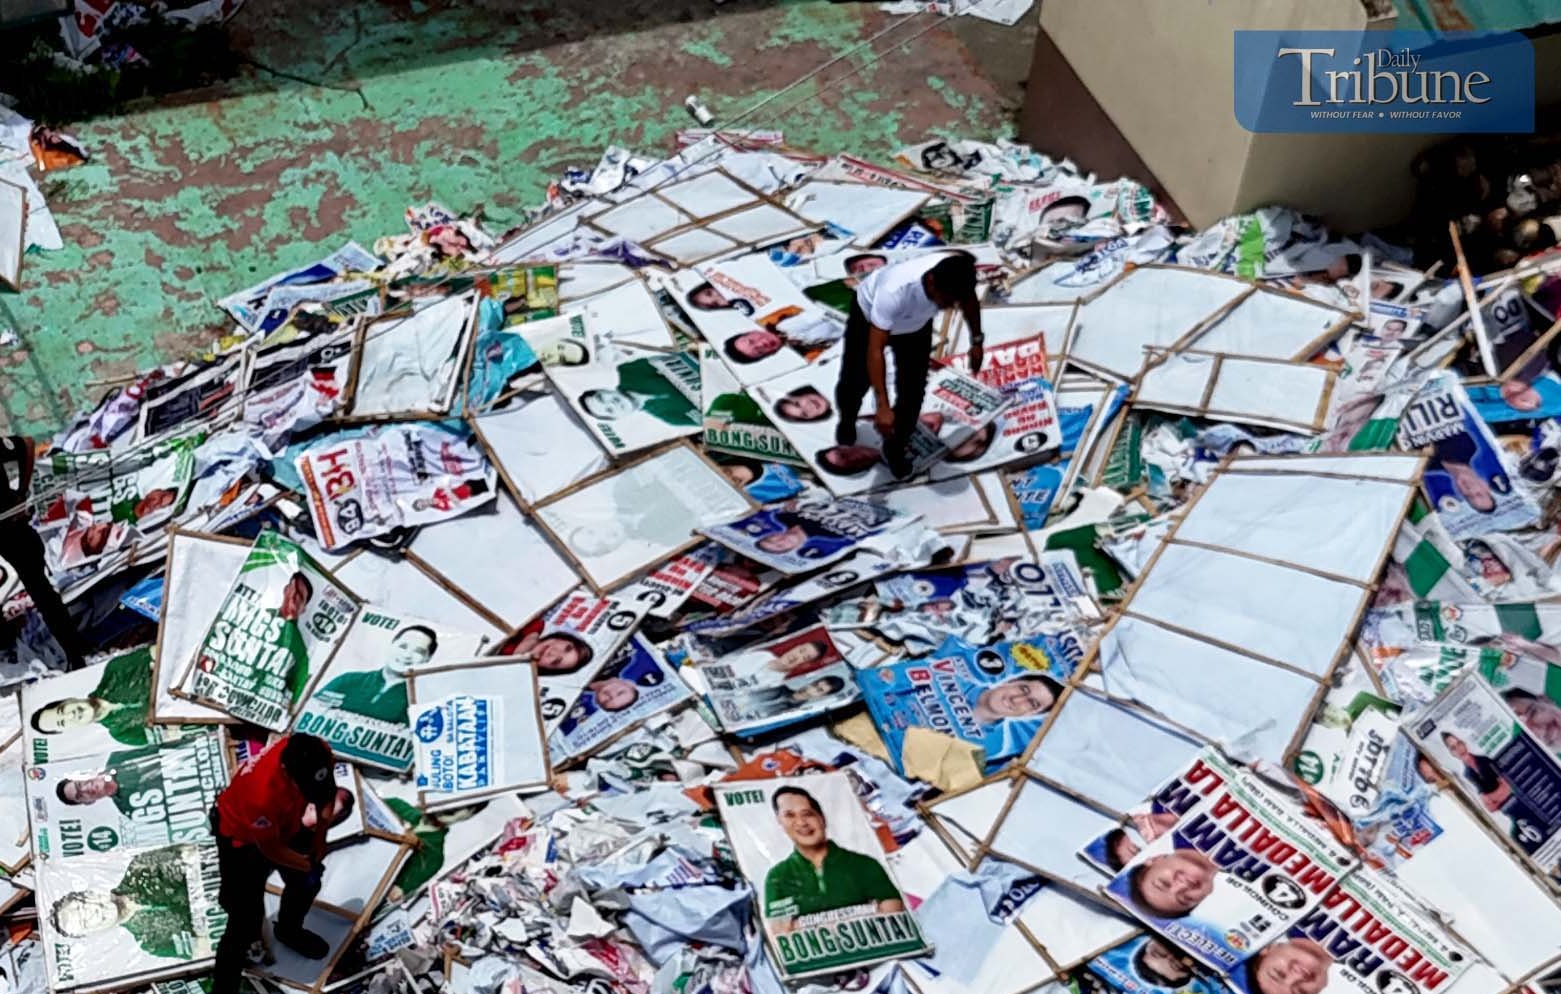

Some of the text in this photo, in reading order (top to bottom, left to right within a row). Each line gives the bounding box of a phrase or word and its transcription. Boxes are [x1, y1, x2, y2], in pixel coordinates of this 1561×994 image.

[707, 428, 754, 450] BONG
[362, 613, 401, 630] VOTE!
[933, 660, 985, 740] VINCENT
[32, 737, 50, 765] VOTE!
[297, 712, 414, 768] BONG SUNTAY
[724, 790, 766, 807] VOTE!
[61, 819, 84, 858] VOTE!
[1180, 813, 1273, 884] RAM
[1210, 793, 1337, 896] MEDALLA
[779, 914, 917, 966] BONG SUNTAY
[1166, 923, 1237, 966] RE-ELECT!
[1295, 905, 1387, 978] RAM
